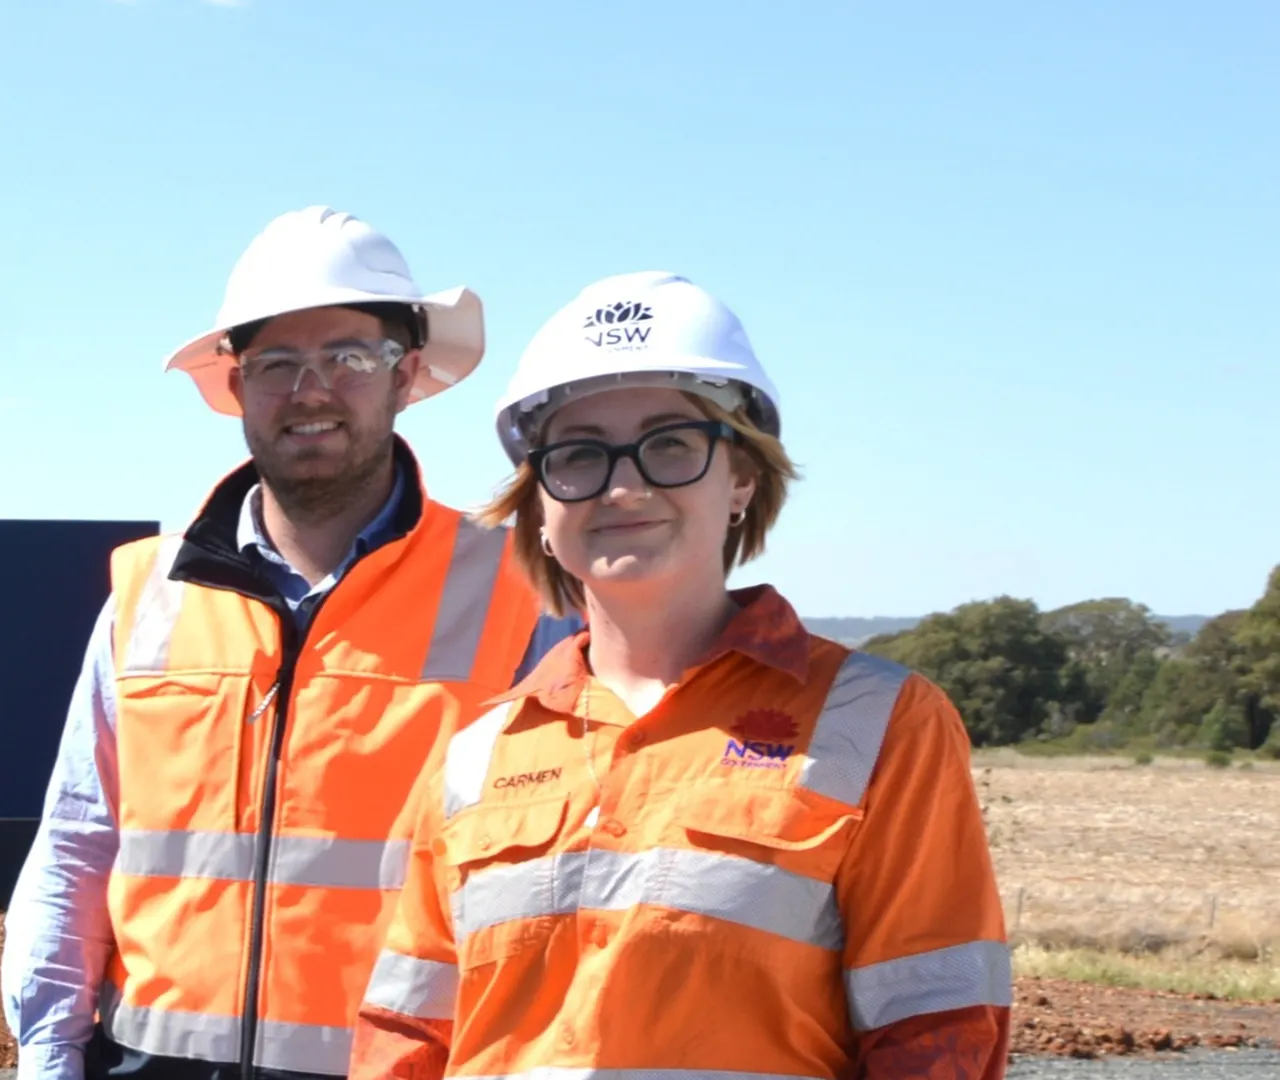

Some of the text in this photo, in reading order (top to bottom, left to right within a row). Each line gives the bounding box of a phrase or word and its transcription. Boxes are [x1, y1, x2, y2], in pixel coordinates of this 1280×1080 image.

[584, 327, 652, 347] NSW
[724, 739, 796, 761] NSW
[493, 767, 562, 789] CARMEN
